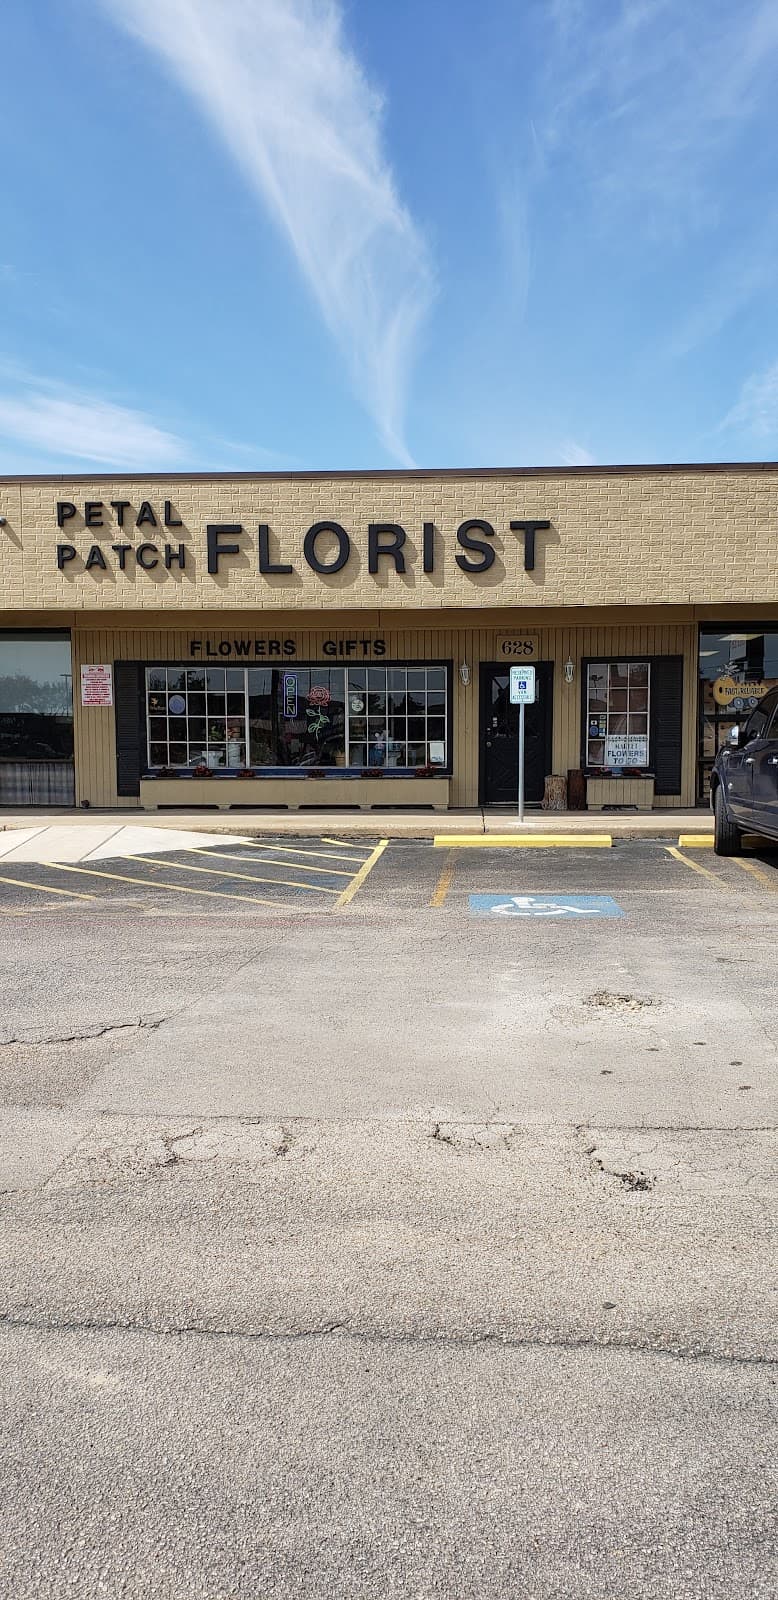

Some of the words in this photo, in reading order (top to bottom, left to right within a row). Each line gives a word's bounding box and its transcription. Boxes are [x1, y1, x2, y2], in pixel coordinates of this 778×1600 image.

[56, 500, 182, 527] PETAL
[56, 543, 186, 569] PATCH
[206, 519, 551, 574] FLORIST
[190, 640, 296, 656] FLOWERS
[323, 640, 386, 656] GIFTS
[502, 640, 534, 655] 628
[286, 677, 296, 715] OPEN
